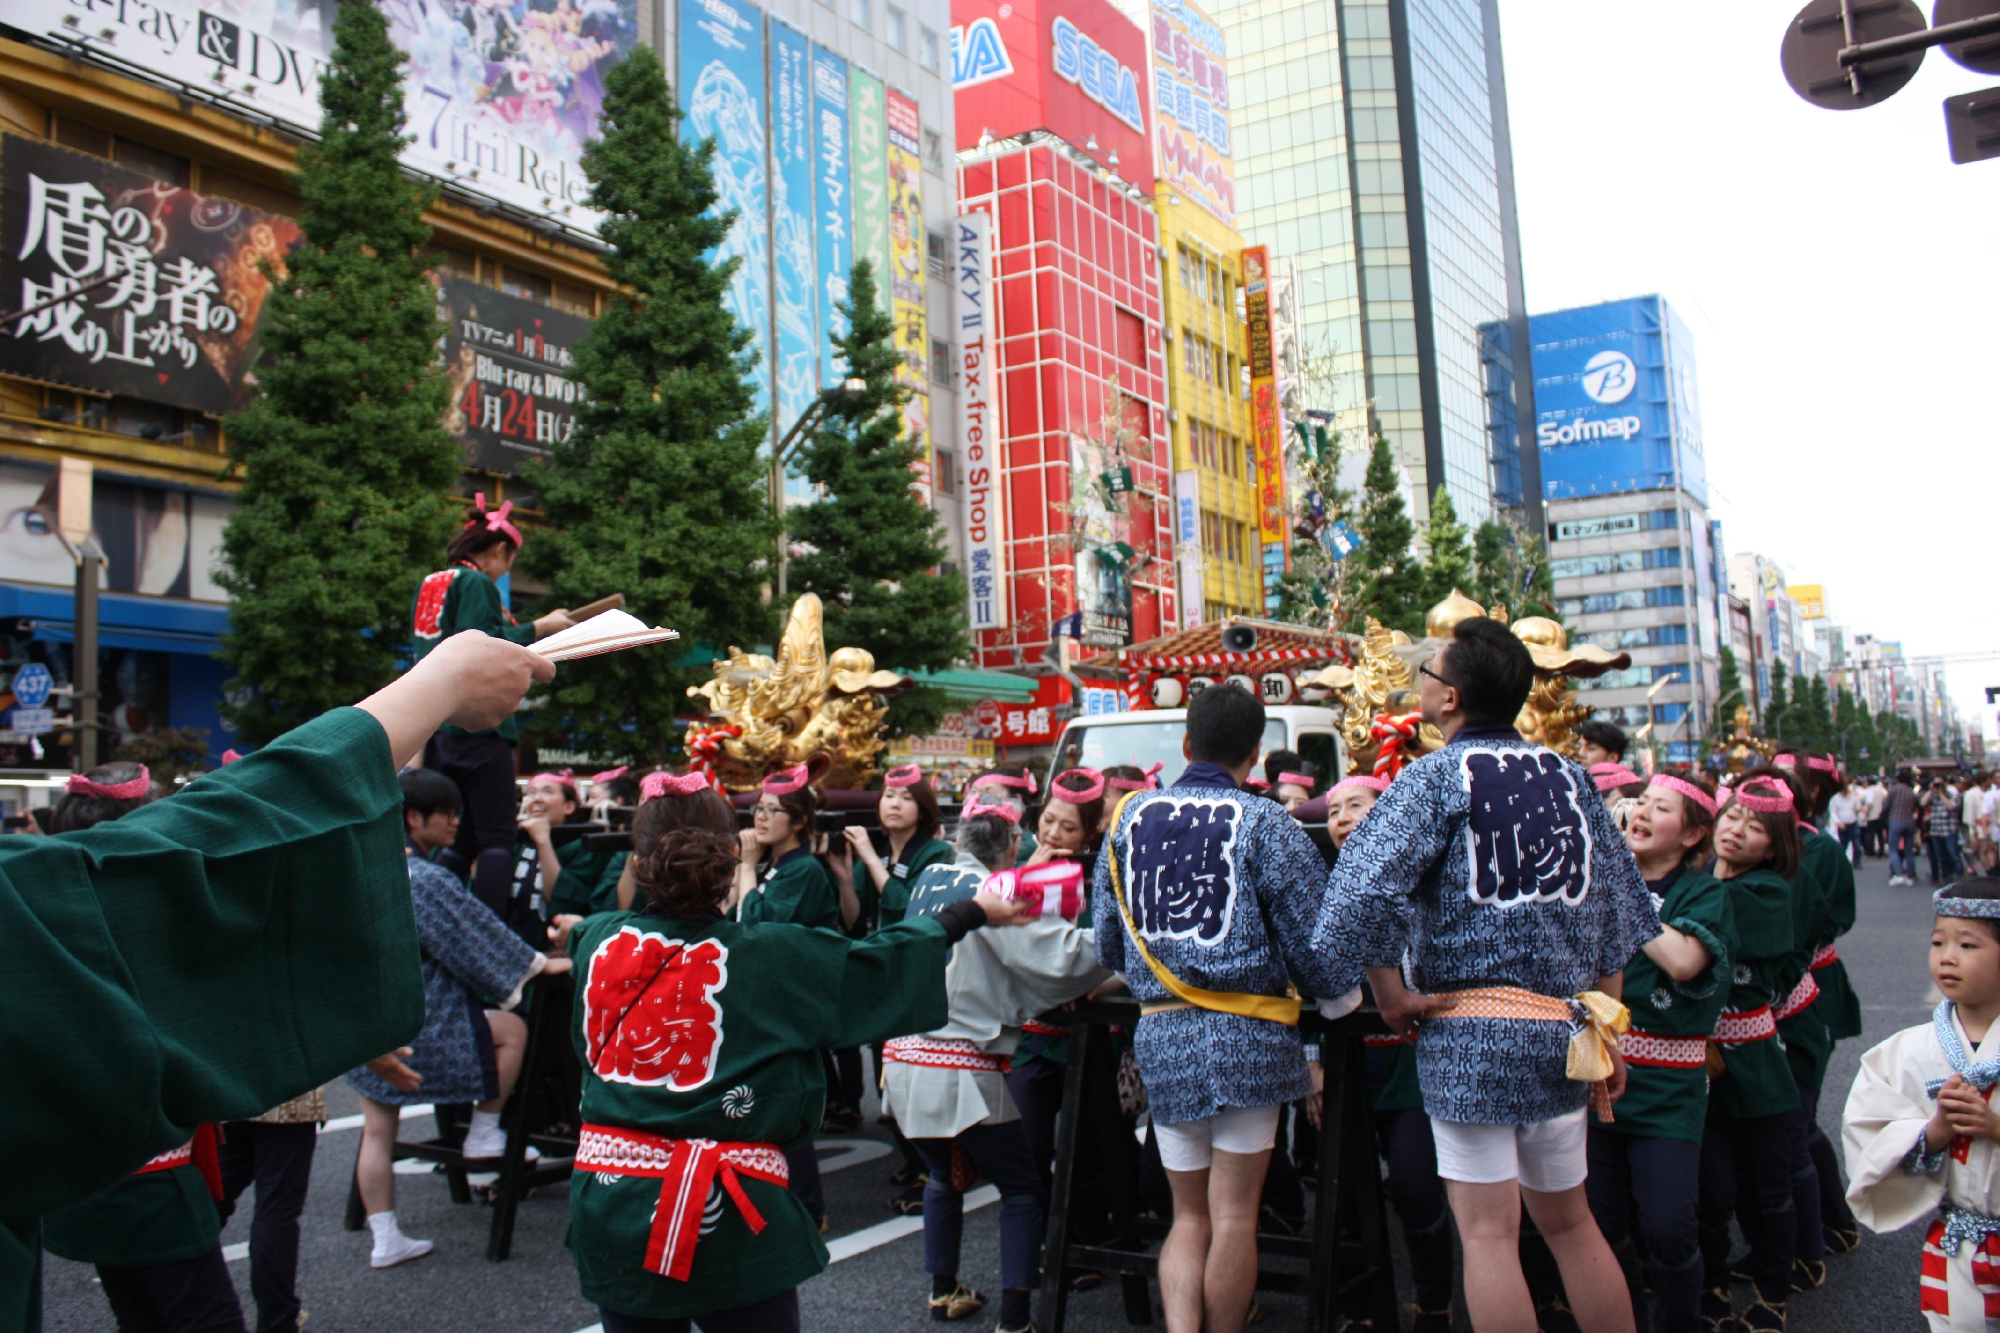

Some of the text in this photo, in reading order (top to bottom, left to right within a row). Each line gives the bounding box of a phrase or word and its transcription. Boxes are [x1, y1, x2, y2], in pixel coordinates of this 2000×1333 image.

[201, 17, 235, 66] &
[249, 30, 333, 95] DV
[1052, 15, 1145, 136] SEGA
[1155, 67, 1230, 156] 高額買取
[518, 142, 585, 206] Rele
[18, 172, 238, 335] 盾の勇者の
[959, 223, 982, 307] AKKY
[14, 271, 198, 369] 成り上がり
[963, 335, 987, 462] Tax-free
[1537, 415, 1641, 447] Sofmap
[969, 467, 990, 543] Shop
[1180, 496, 1196, 542] SEGA
[17, 675, 49, 694] 437
